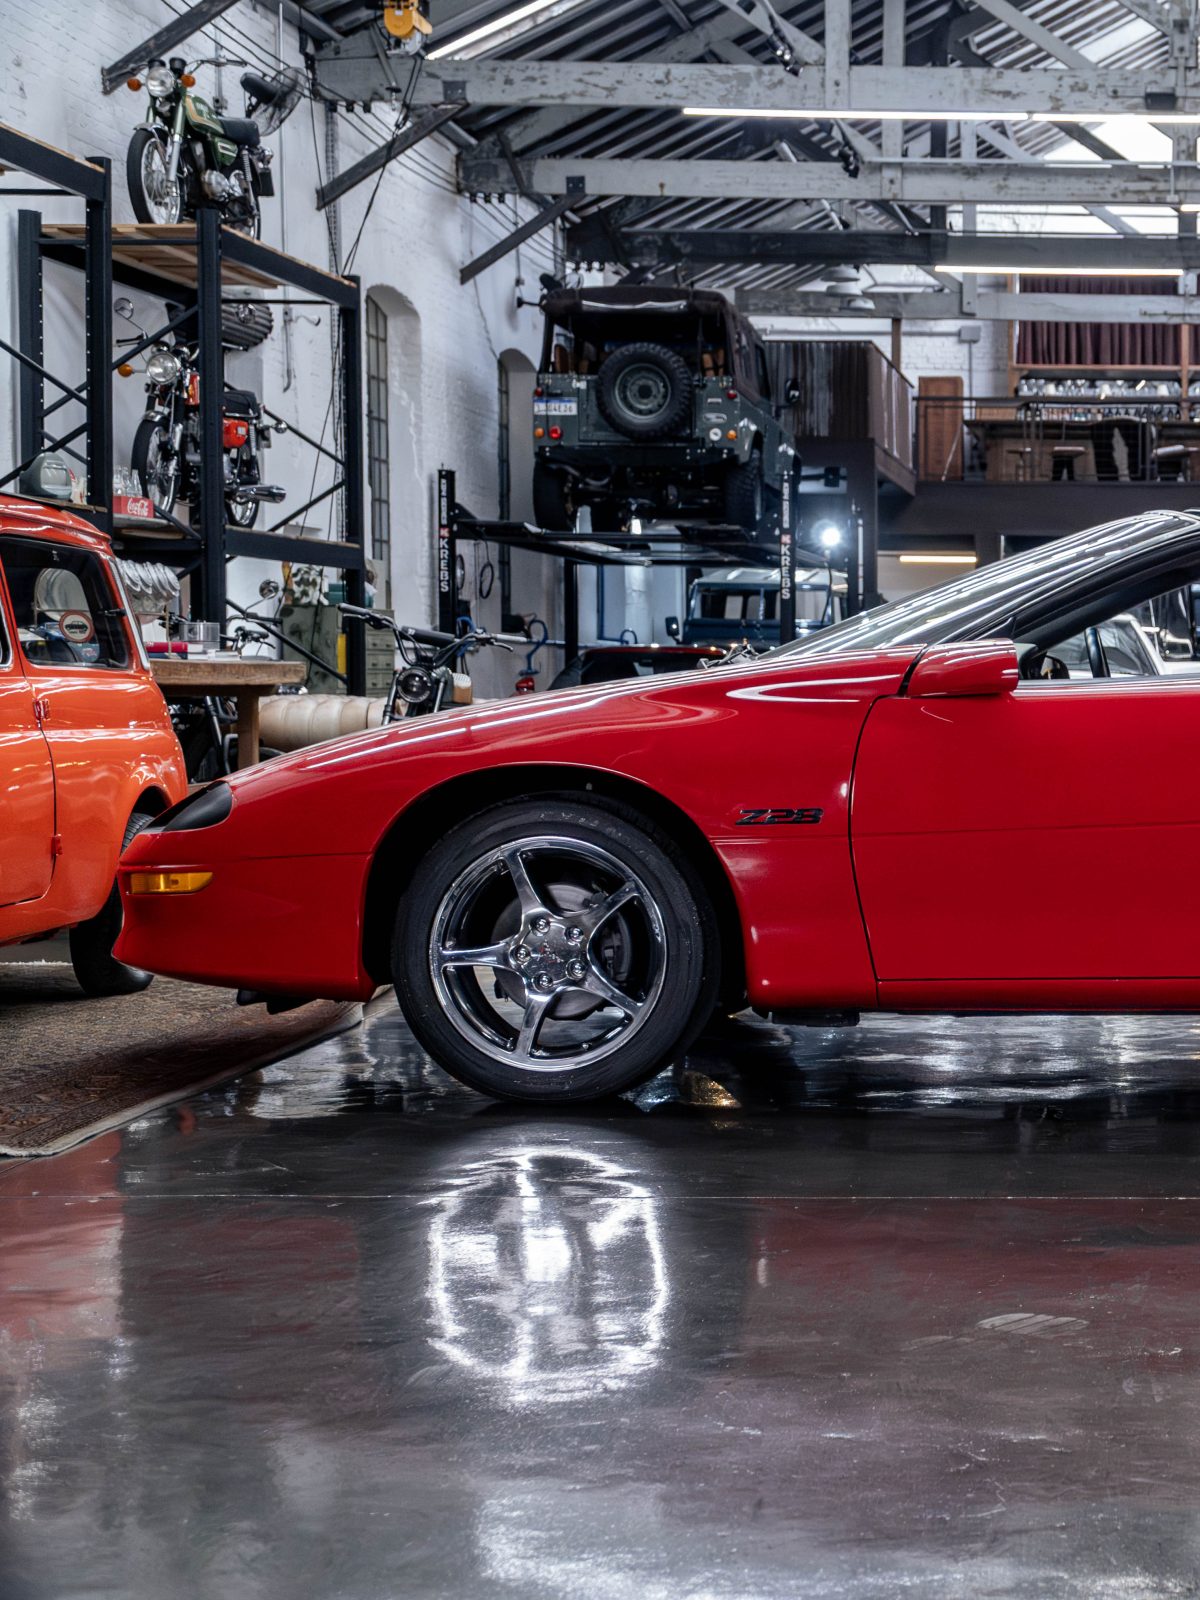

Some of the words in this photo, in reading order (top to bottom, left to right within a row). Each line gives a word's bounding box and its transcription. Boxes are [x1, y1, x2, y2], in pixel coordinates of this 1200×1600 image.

[440, 538, 449, 592] KREBS
[781, 545, 791, 599] KREBS
[736, 808, 823, 825] Z28
